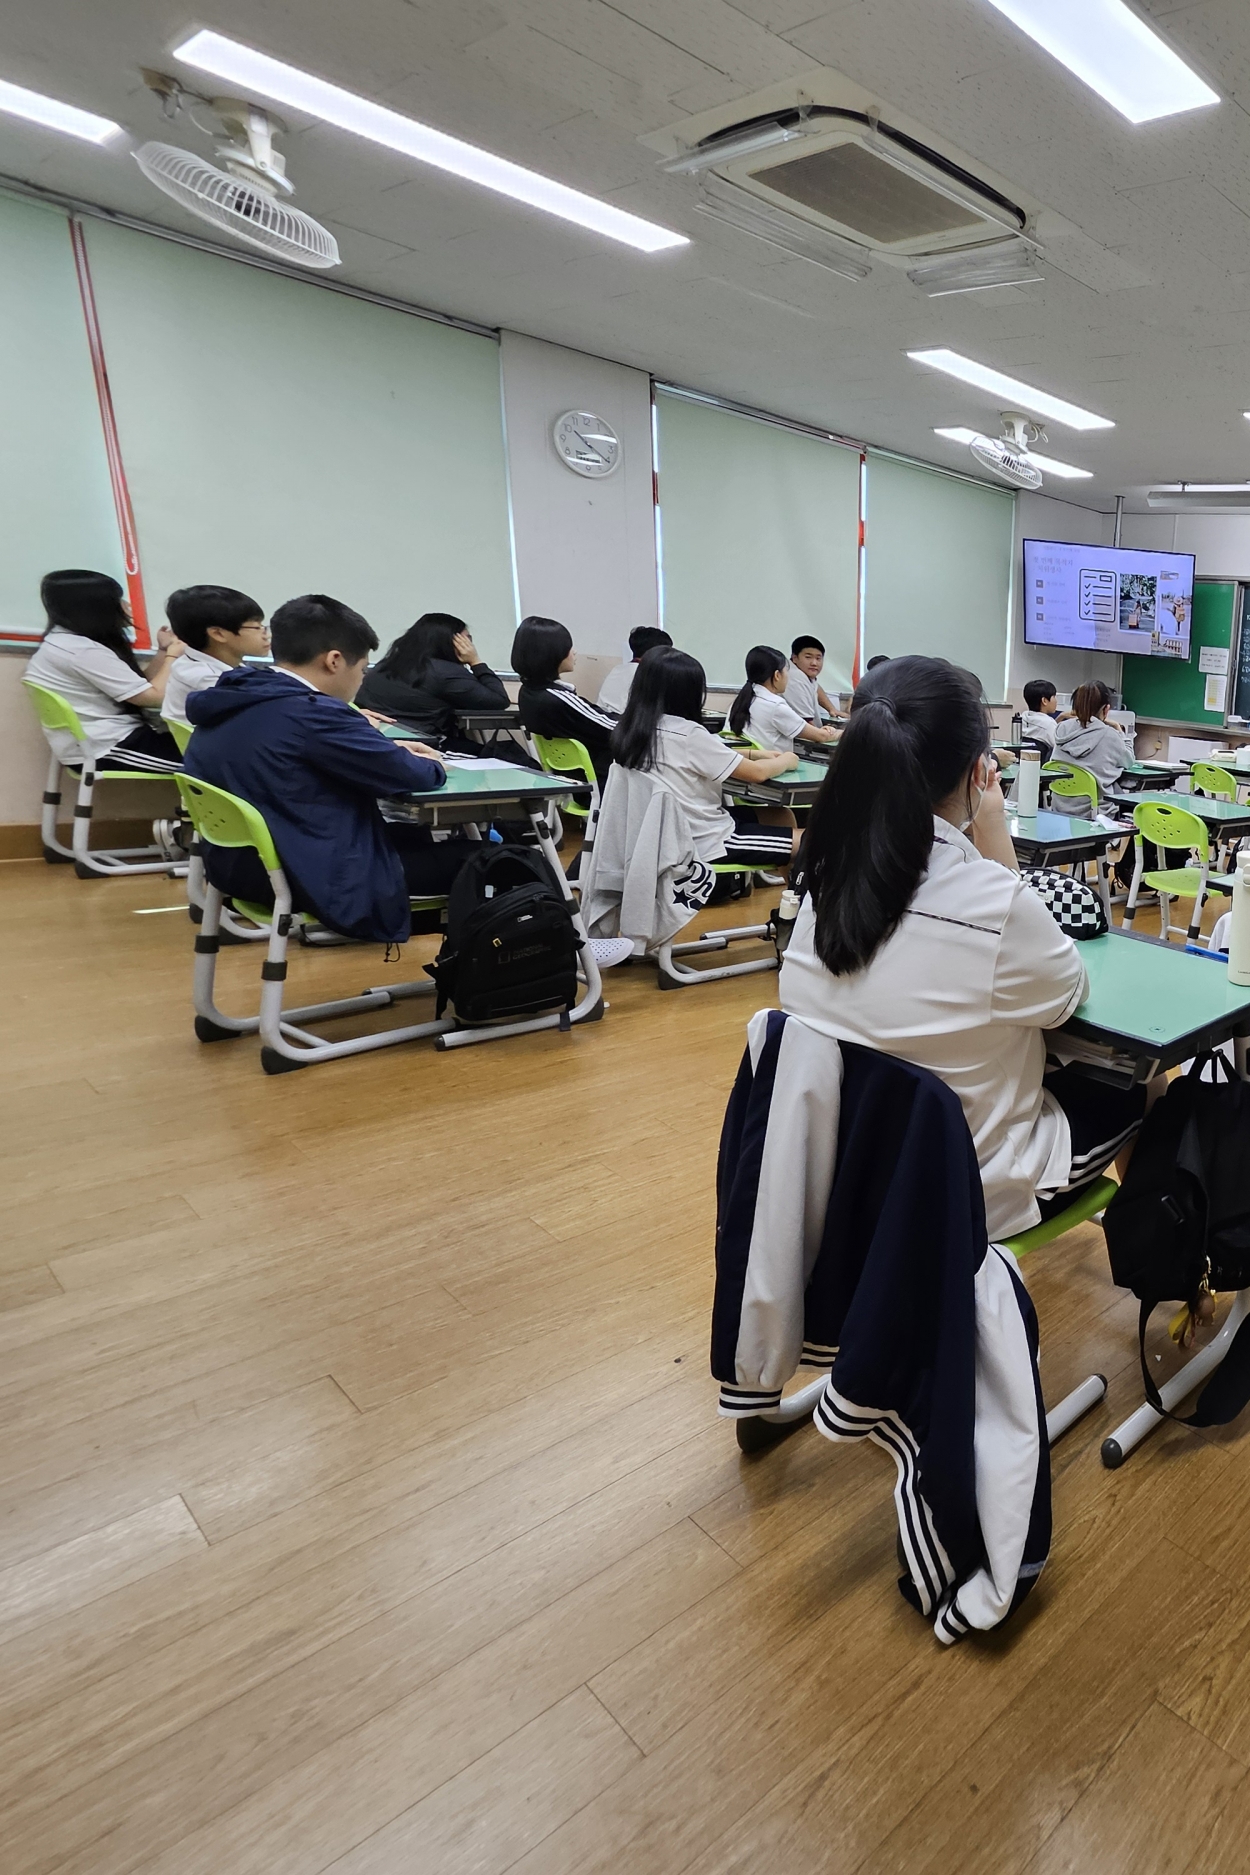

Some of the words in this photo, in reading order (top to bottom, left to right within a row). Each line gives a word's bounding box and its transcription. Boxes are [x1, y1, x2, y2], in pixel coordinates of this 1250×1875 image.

[572, 416, 579, 426] 11
[582, 416, 591, 427] 12
[563, 423, 573, 433] 10
[560, 433, 566, 443] 9
